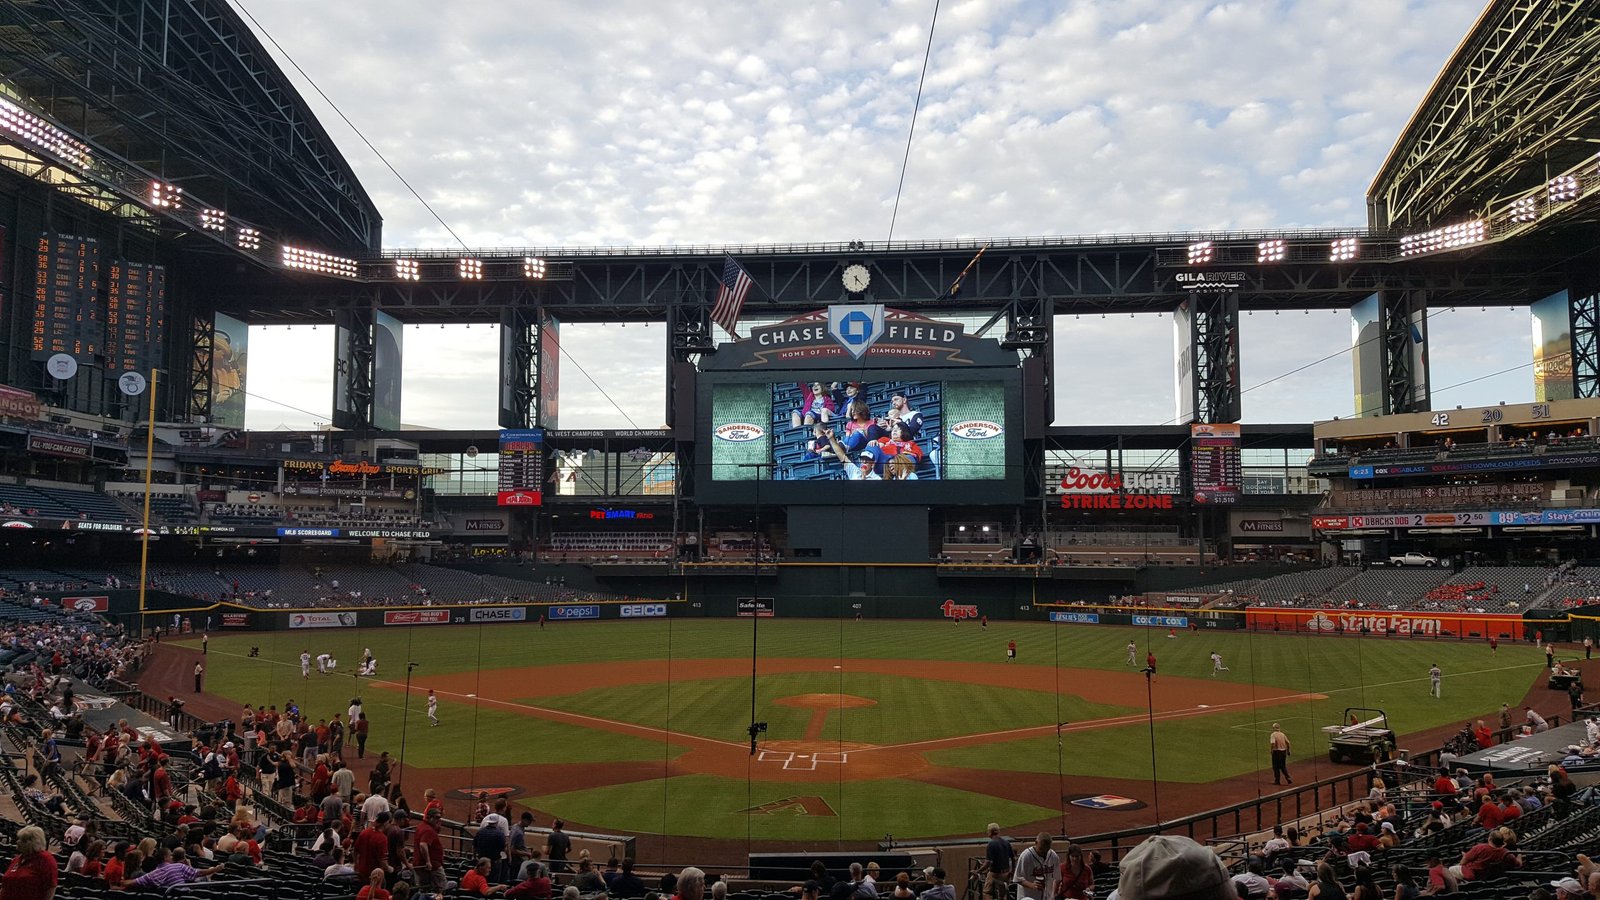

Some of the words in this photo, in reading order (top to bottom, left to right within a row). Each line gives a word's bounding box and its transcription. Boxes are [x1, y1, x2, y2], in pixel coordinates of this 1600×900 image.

[759, 328, 824, 346] CHASE
[889, 326, 956, 342] FIELD
[871, 348, 932, 356] DIAMONDBACKS
[1432, 414, 1449, 426] 42
[1482, 409, 1502, 422] 20
[1532, 404, 1550, 418] 51
[718, 424, 761, 434] SANDERSON
[953, 422, 1000, 432] SANDERSON
[728, 431, 750, 440] Ford
[966, 429, 988, 438] Ford
[73, 446, 86, 455] SEATS
[284, 461, 324, 470] FRIDAY'S
[386, 466, 419, 474] SPORTS
[1061, 467, 1123, 489] Coors
[1123, 472, 1180, 489] LIGHT
[1360, 490, 1391, 499] DRAFT
[1393, 489, 1421, 498] ROOM
[1438, 487, 1470, 496] CRAFT
[1471, 485, 1498, 496] BEER
[1500, 485, 1511, 494] &
[1514, 484, 1544, 494] BITES
[1061, 495, 1120, 508] STRIKE
[1124, 495, 1172, 508] ZONE
[1395, 517, 1408, 525] DOG
[1415, 515, 1422, 526] 2
[1548, 512, 1573, 521] Stays
[475, 609, 510, 618] CHASE
[567, 606, 592, 617] pepsi
[620, 605, 666, 616] GEICO
[1339, 613, 1387, 632] State
[1390, 614, 1441, 633] Farm
